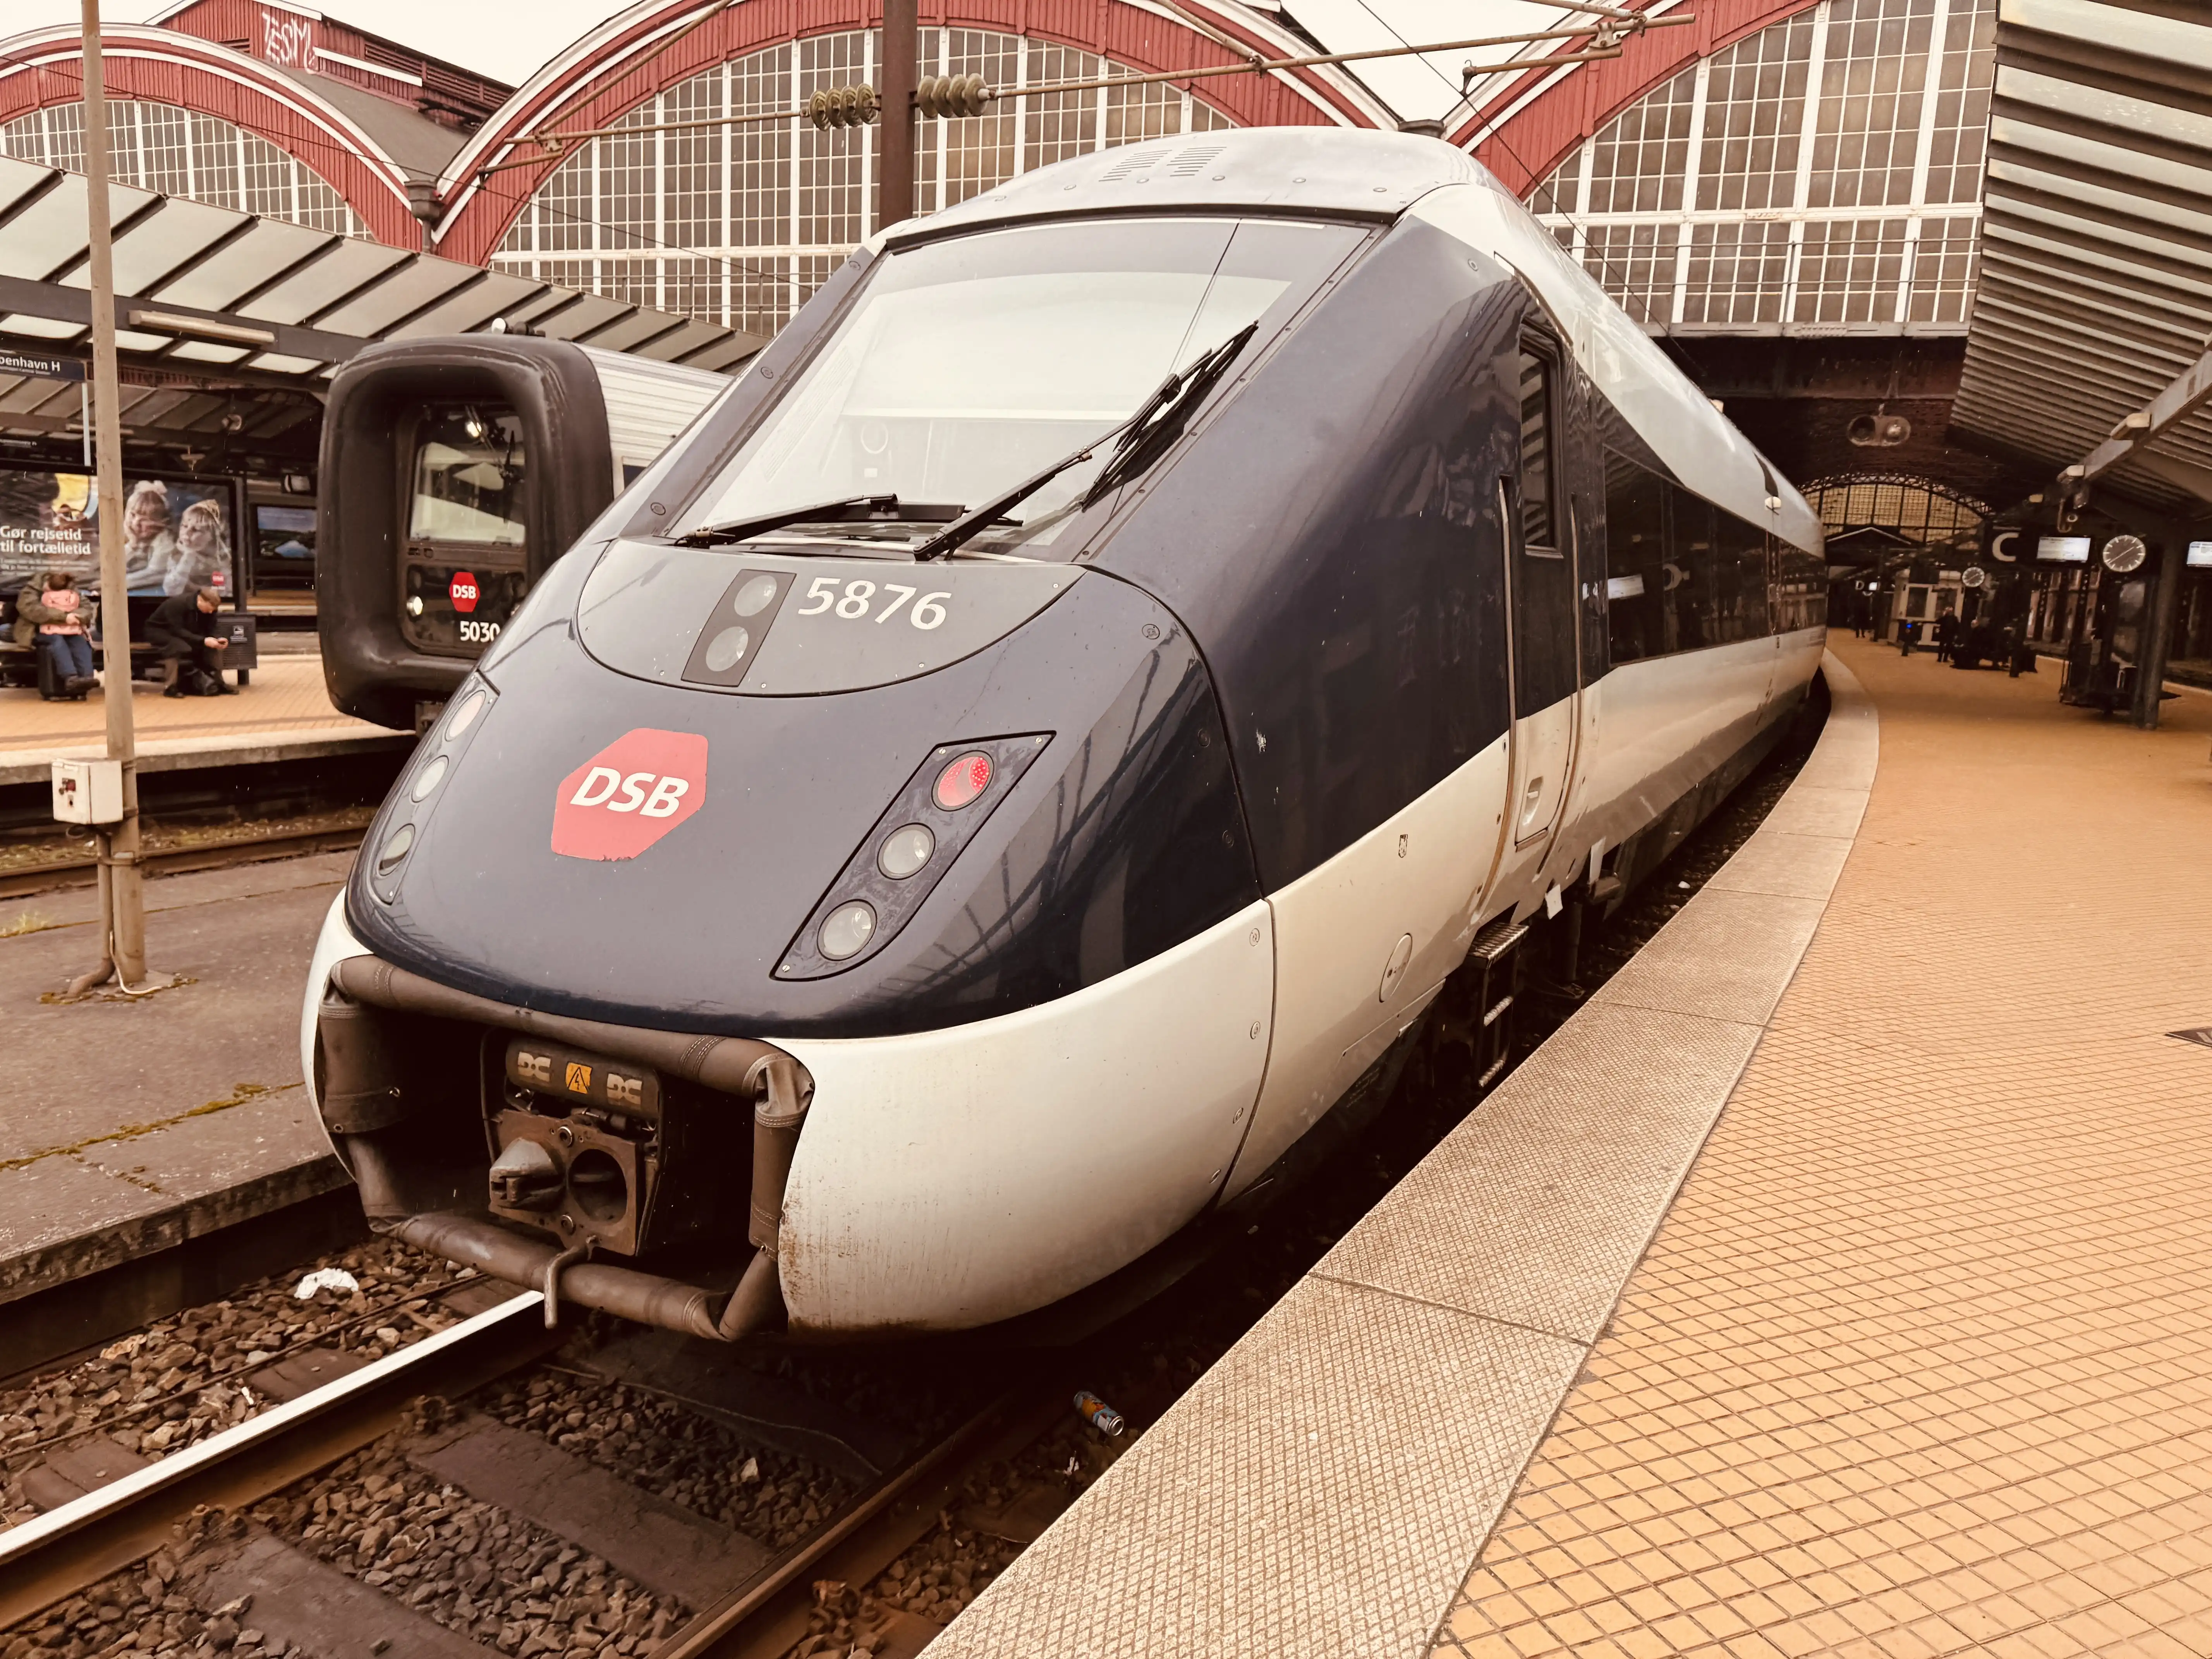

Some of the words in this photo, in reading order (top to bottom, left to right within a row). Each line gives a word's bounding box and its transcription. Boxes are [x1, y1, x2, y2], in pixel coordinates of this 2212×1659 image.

[51, 360, 60, 372] H
[0, 525, 27, 539] Gør
[30, 527, 82, 542] rejsetid
[0, 540, 14, 553] til
[19, 539, 91, 555] fortælletid
[1992, 532, 2019, 562] C
[453, 584, 476, 599] DSB
[1855, 580, 1865, 590] D
[798, 577, 951, 630] 5876
[460, 620, 500, 642] 5030
[570, 766, 689, 817] DSB
